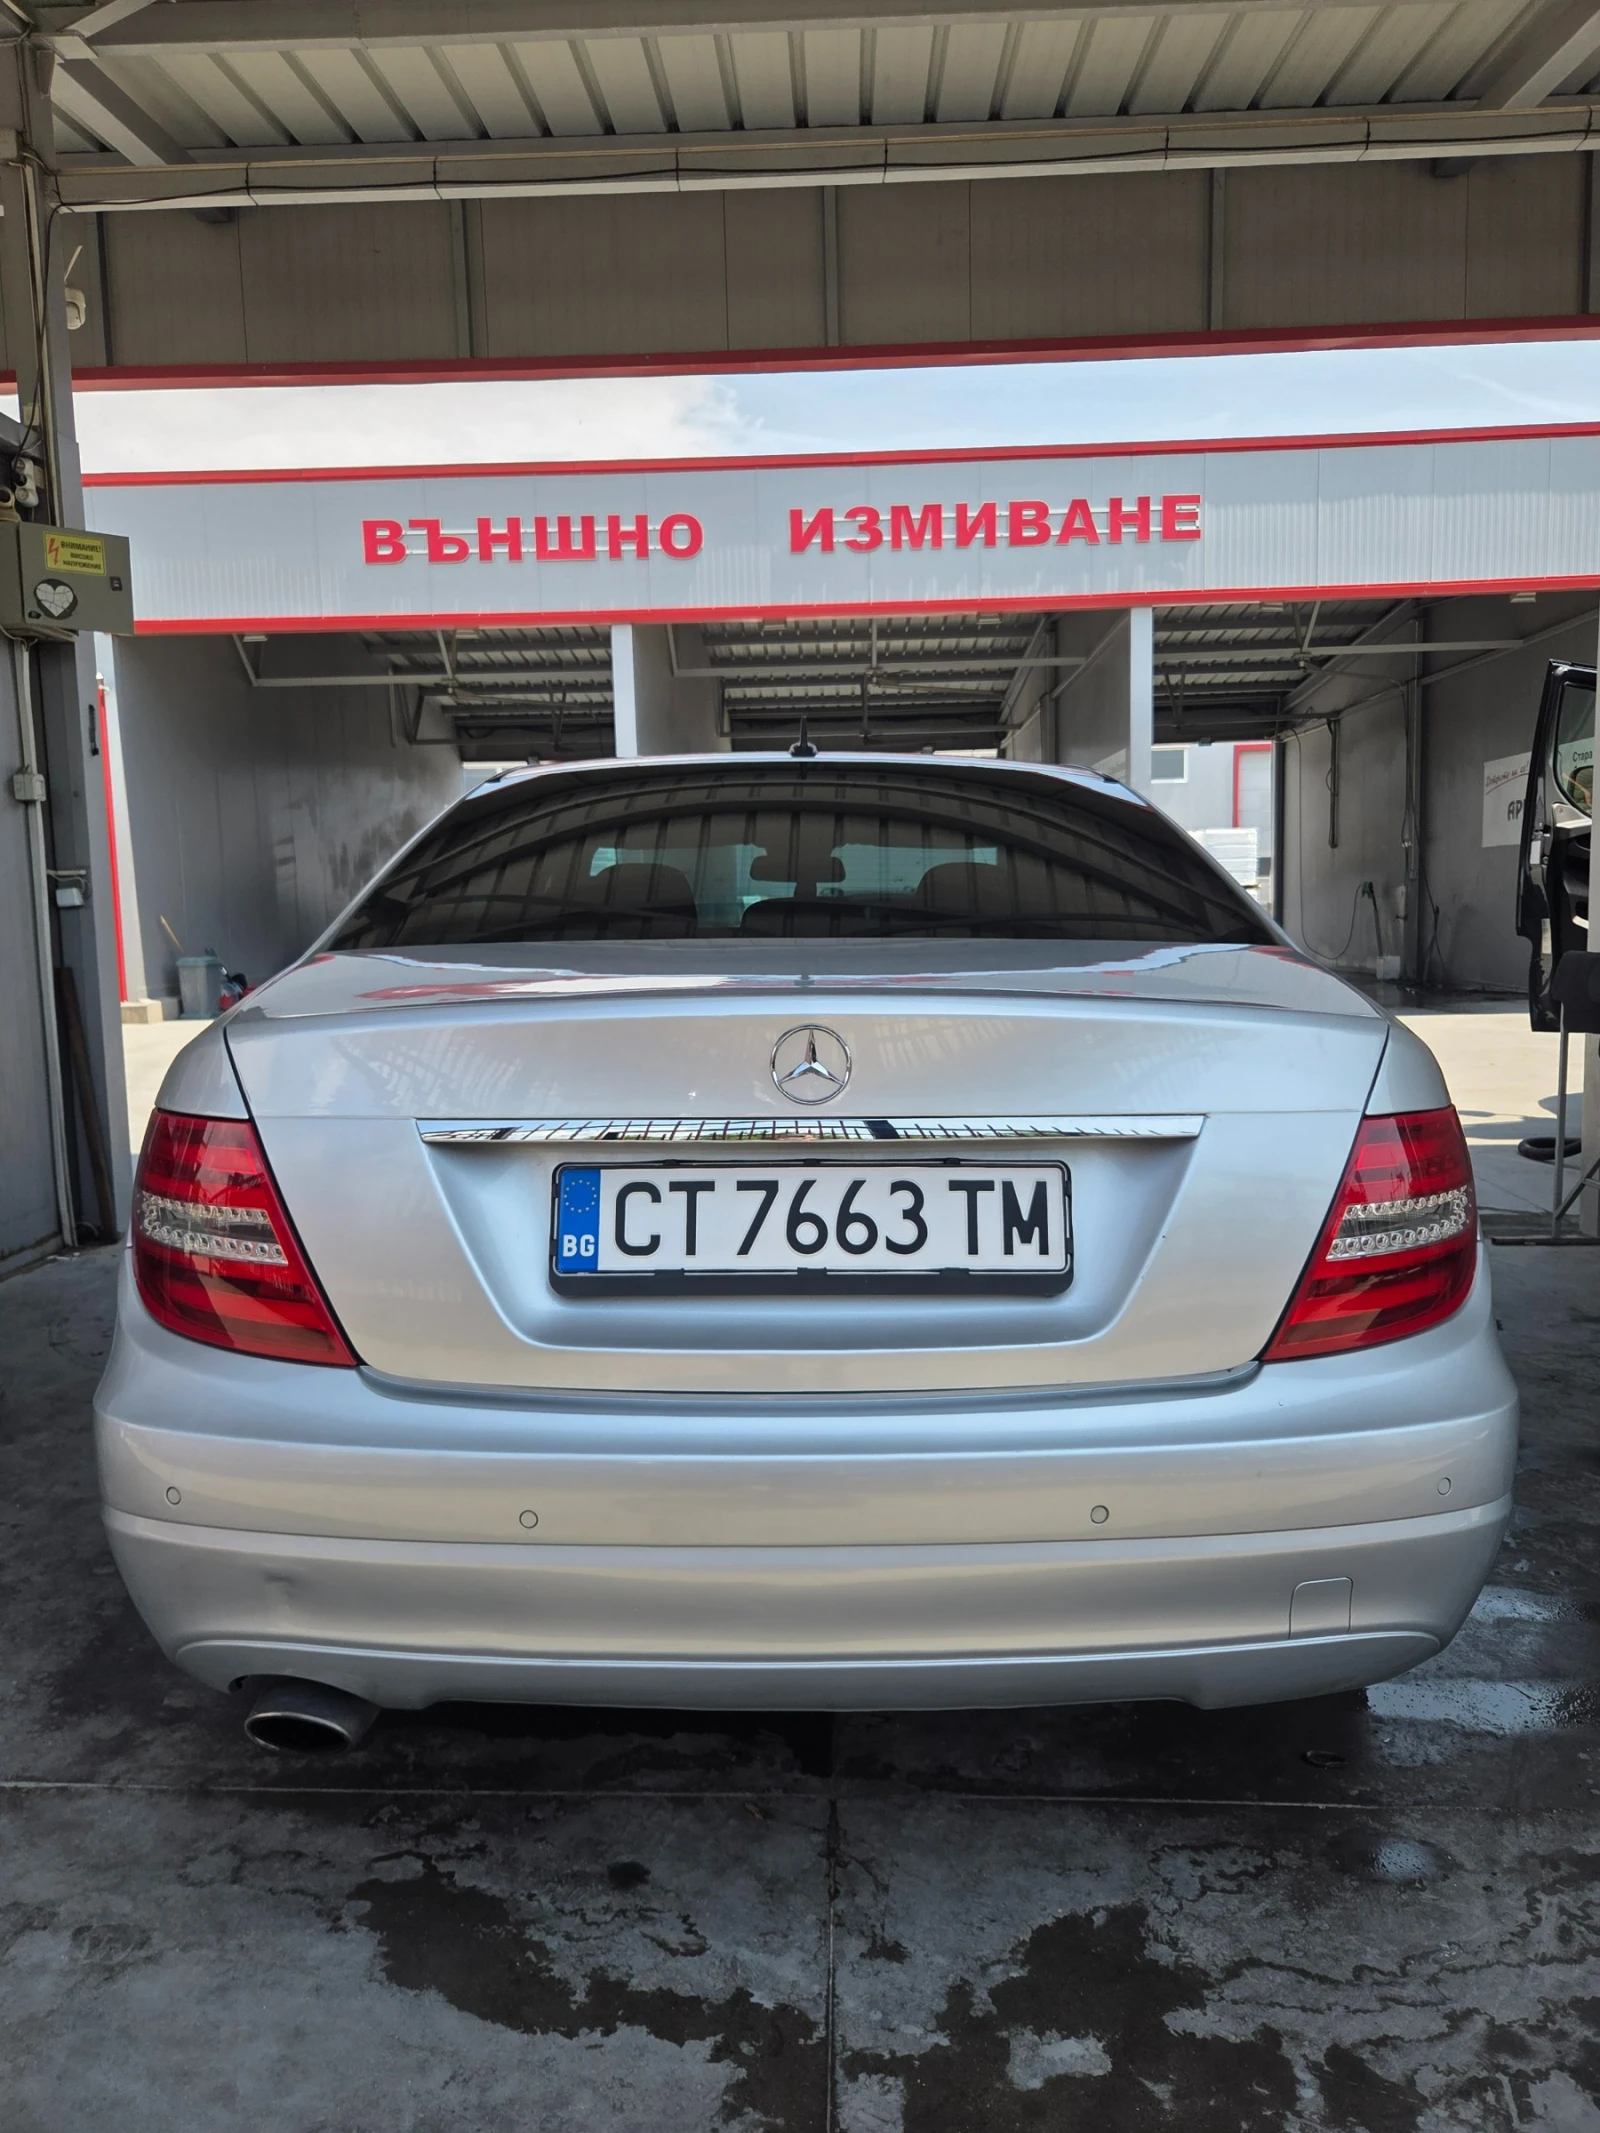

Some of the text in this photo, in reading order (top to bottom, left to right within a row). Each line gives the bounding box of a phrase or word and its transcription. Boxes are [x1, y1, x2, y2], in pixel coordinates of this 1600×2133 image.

[61, 541, 101, 553] ВНИМАНИЕ!
[361, 494, 1202, 564] ВЪНШНО ИЗМИВАНЕ
[615, 1179, 1049, 1256] CT 7663 TM
[562, 1234, 595, 1257] BG
